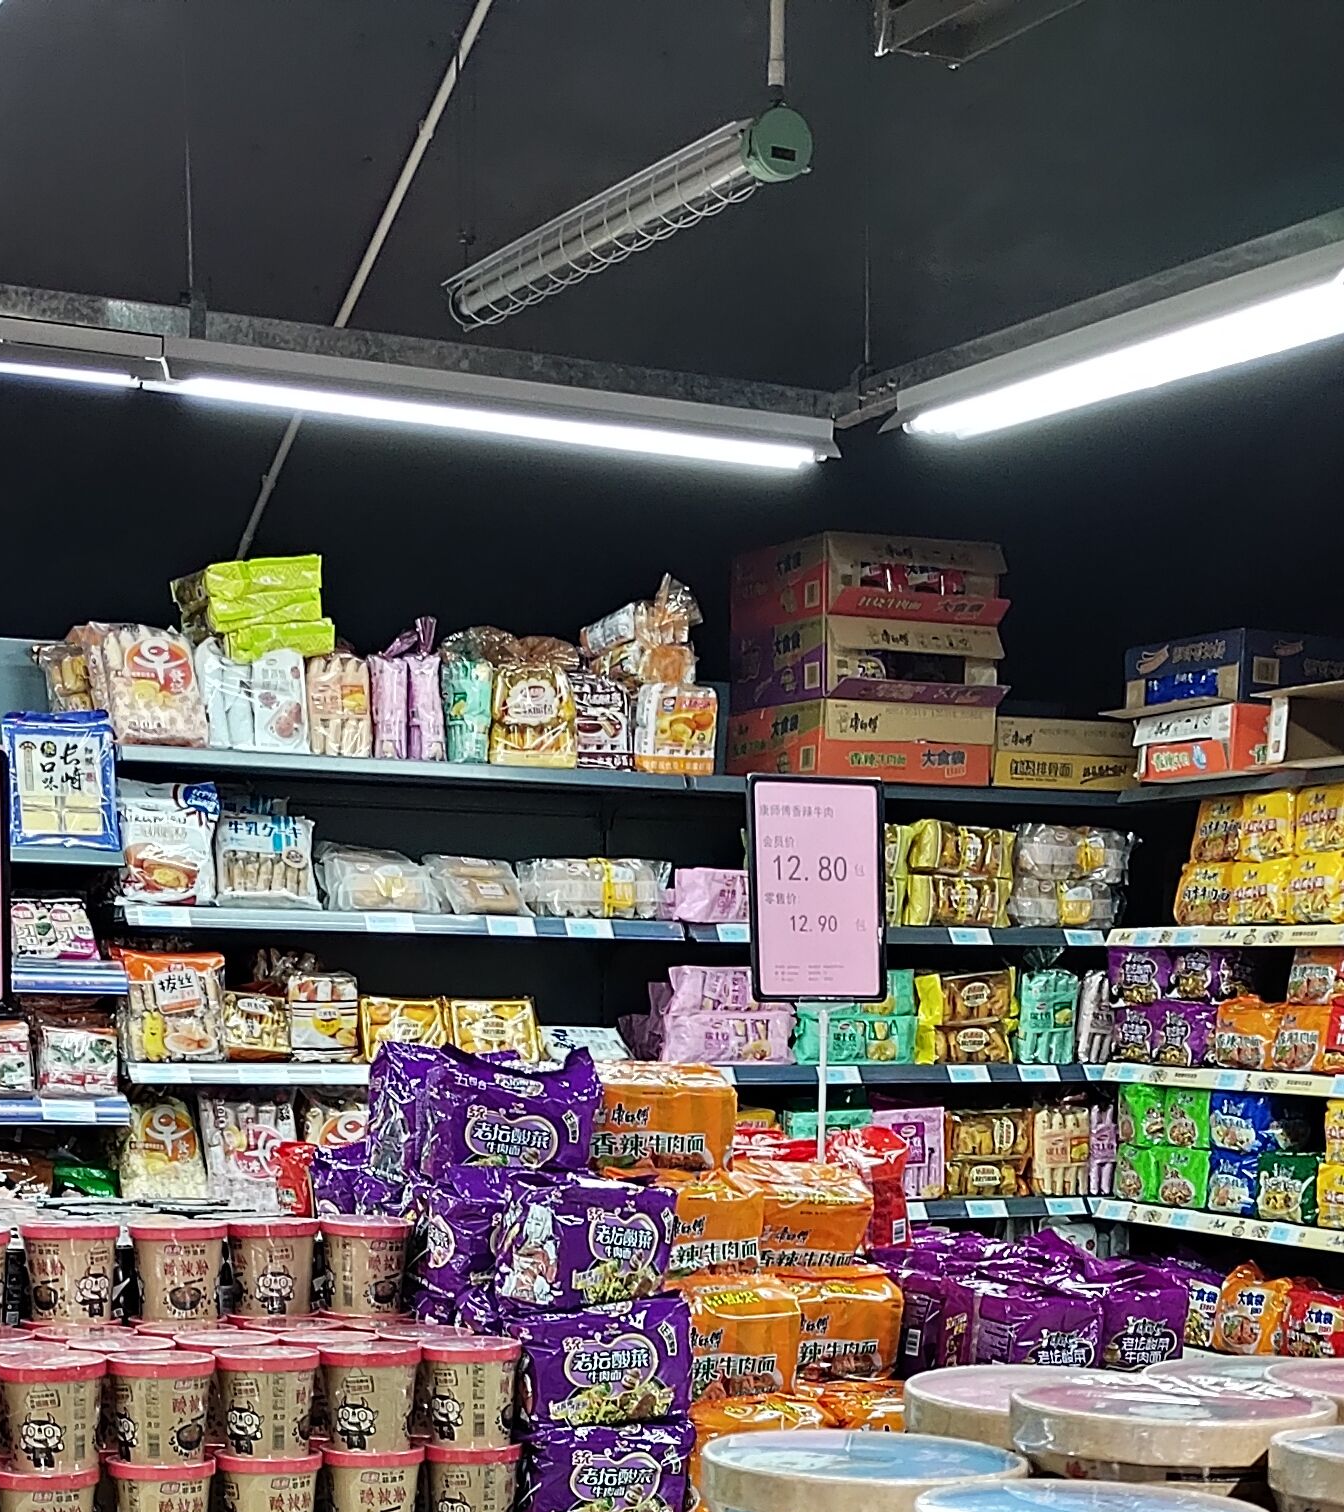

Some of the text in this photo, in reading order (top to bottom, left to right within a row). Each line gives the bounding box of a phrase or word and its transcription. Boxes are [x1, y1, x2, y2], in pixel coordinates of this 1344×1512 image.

[773, 855, 848, 882] 12.80
[790, 915, 838, 932] 12.90
[611, 1102, 650, 1127] 康师傅
[473, 1122, 551, 1149] 老坛酸菜
[592, 1134, 704, 1157] 香辣牛肉面
[486, 1142, 521, 1155] 牛肉面
[596, 1224, 653, 1249] 老坛酸菜
[604, 1247, 632, 1261] 牛肉面
[573, 1348, 649, 1372] 老坛酸菜
[587, 1368, 622, 1382] 牛肉面
[579, 1467, 654, 1486] 老坛酸菜
[591, 1484, 625, 1498] 牛肉面
